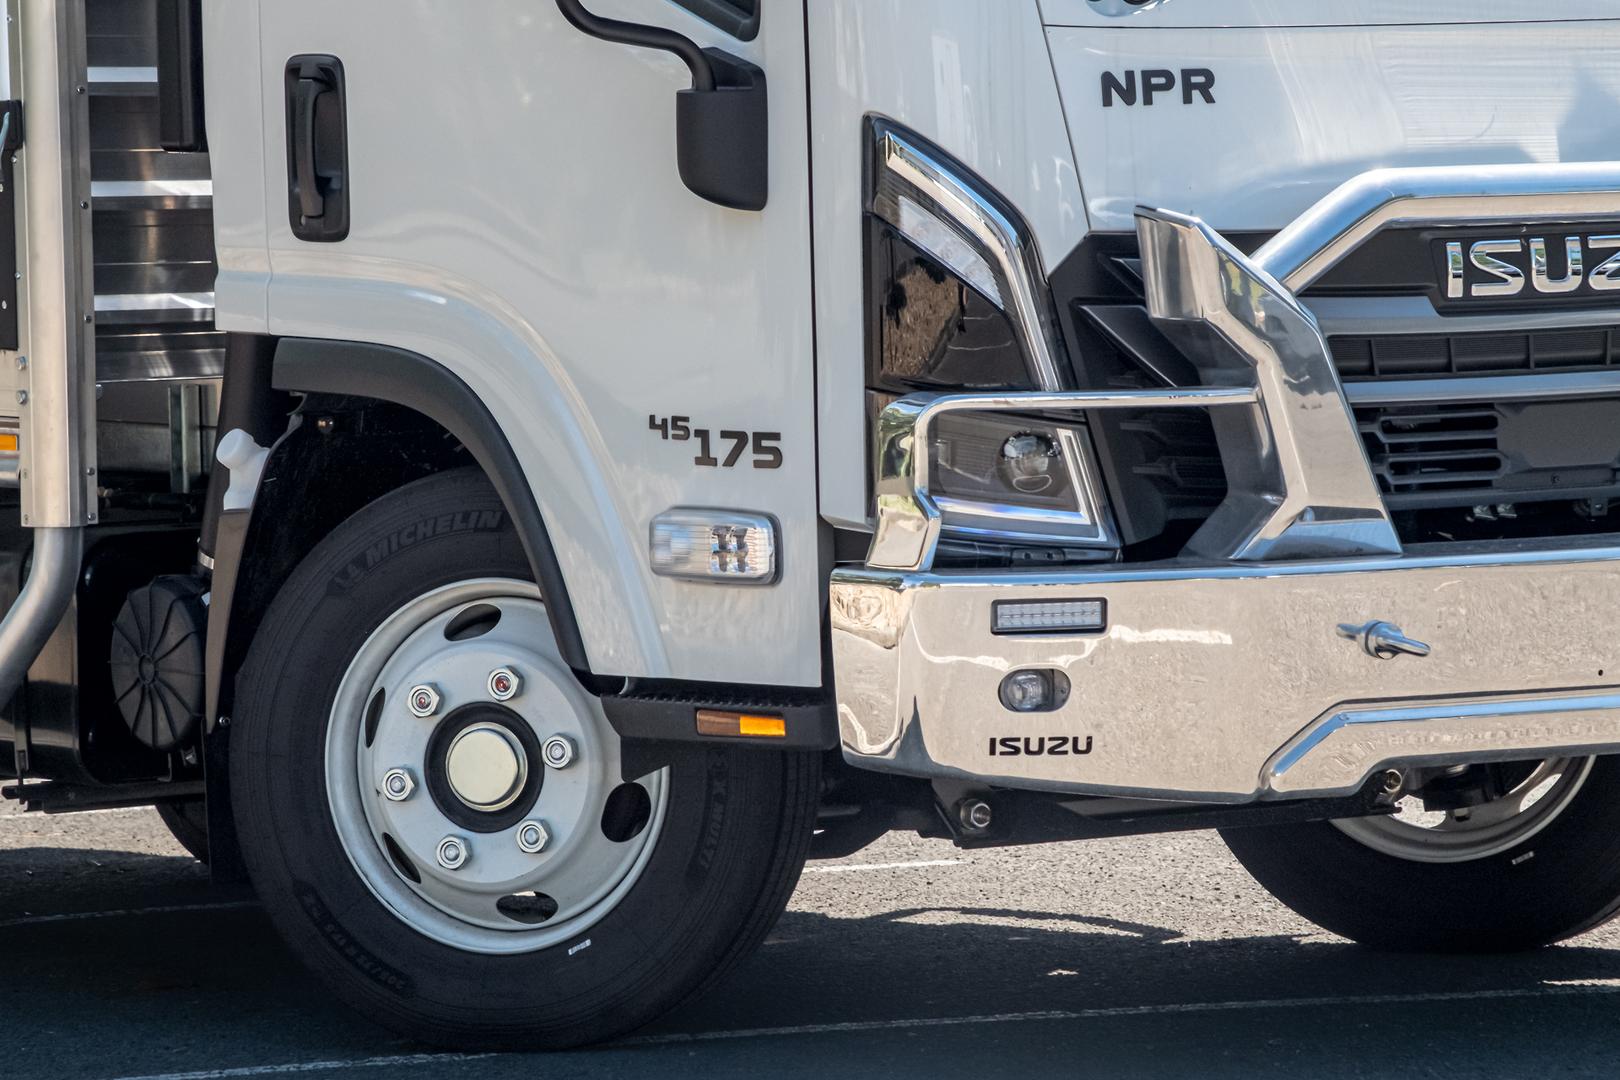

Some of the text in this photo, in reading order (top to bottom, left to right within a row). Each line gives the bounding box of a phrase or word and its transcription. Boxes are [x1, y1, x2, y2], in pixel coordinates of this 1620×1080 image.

[1101, 68, 1216, 107] NPR
[649, 414, 783, 469] 45 175
[364, 511, 502, 569] MICHELIN
[989, 736, 1093, 756] ISUZU
